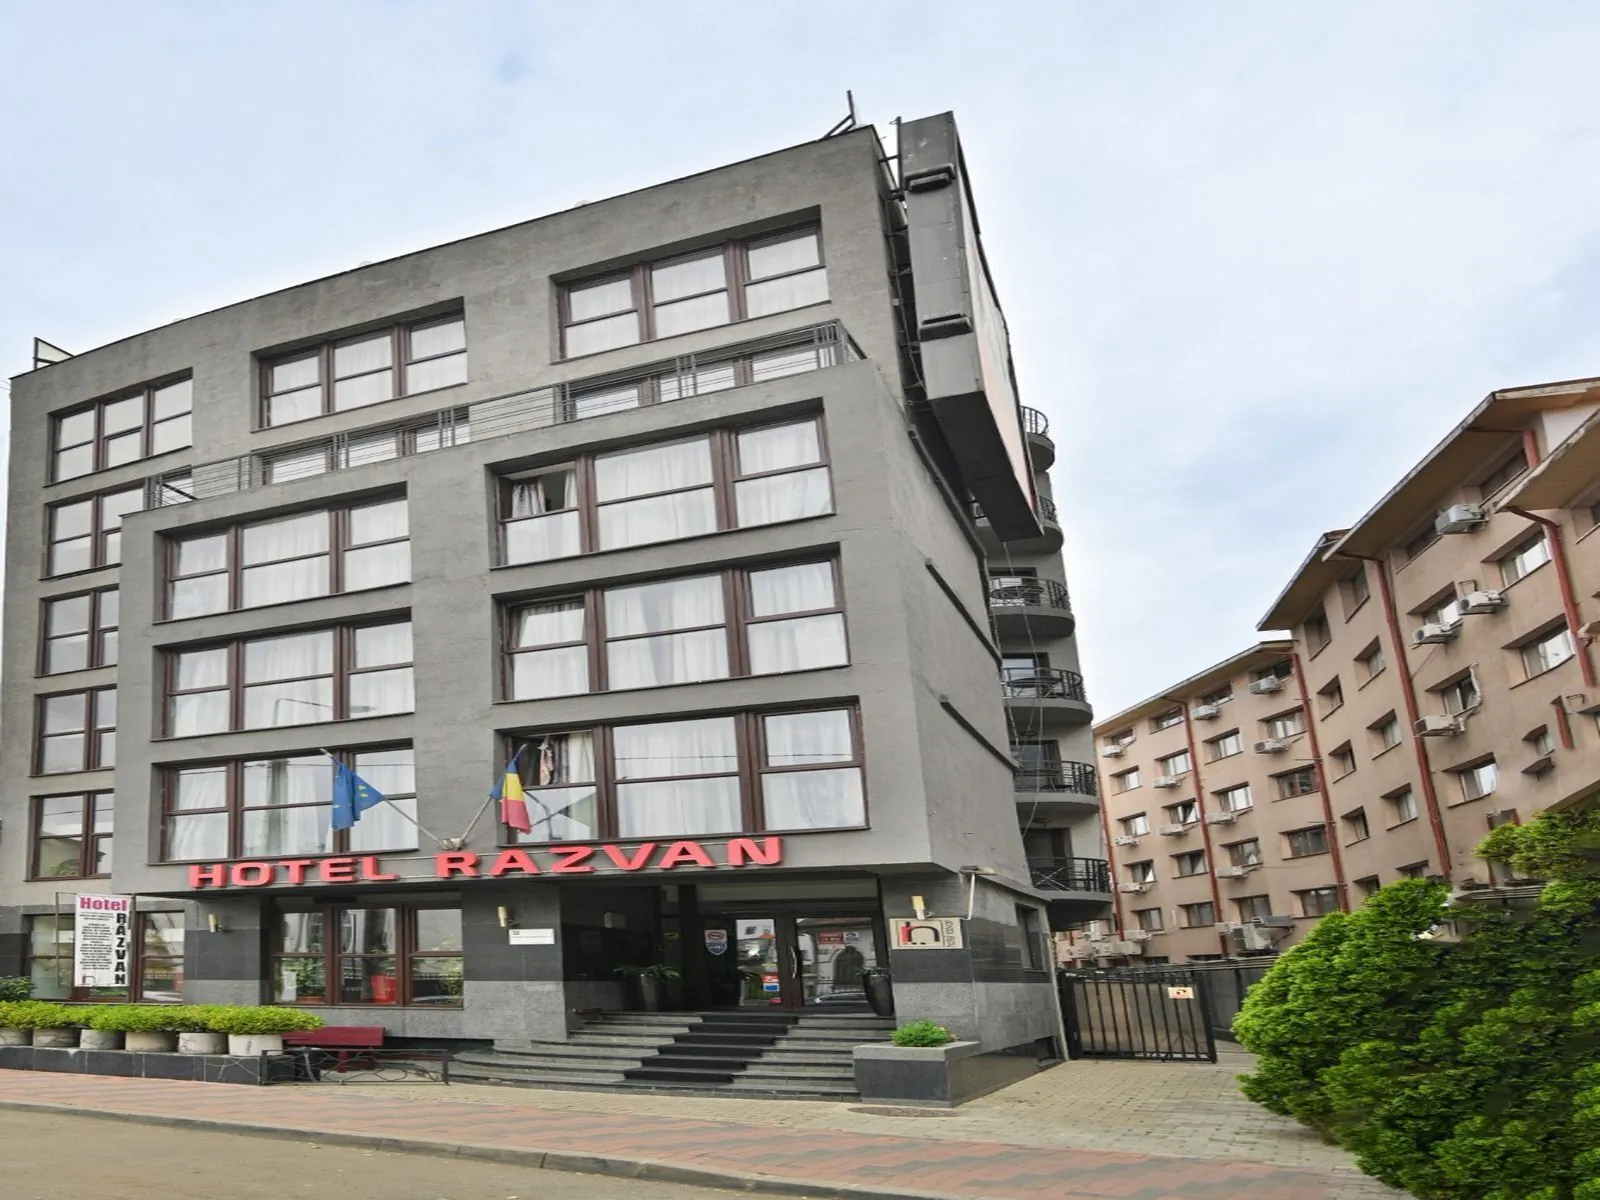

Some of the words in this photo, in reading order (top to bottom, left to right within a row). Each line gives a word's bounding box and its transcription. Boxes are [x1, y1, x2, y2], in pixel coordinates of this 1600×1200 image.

[188, 856, 399, 889] HOTEL
[434, 836, 783, 878] RAZVAN
[80, 897, 127, 911] Hotel
[114, 913, 127, 985] RAZVAN
